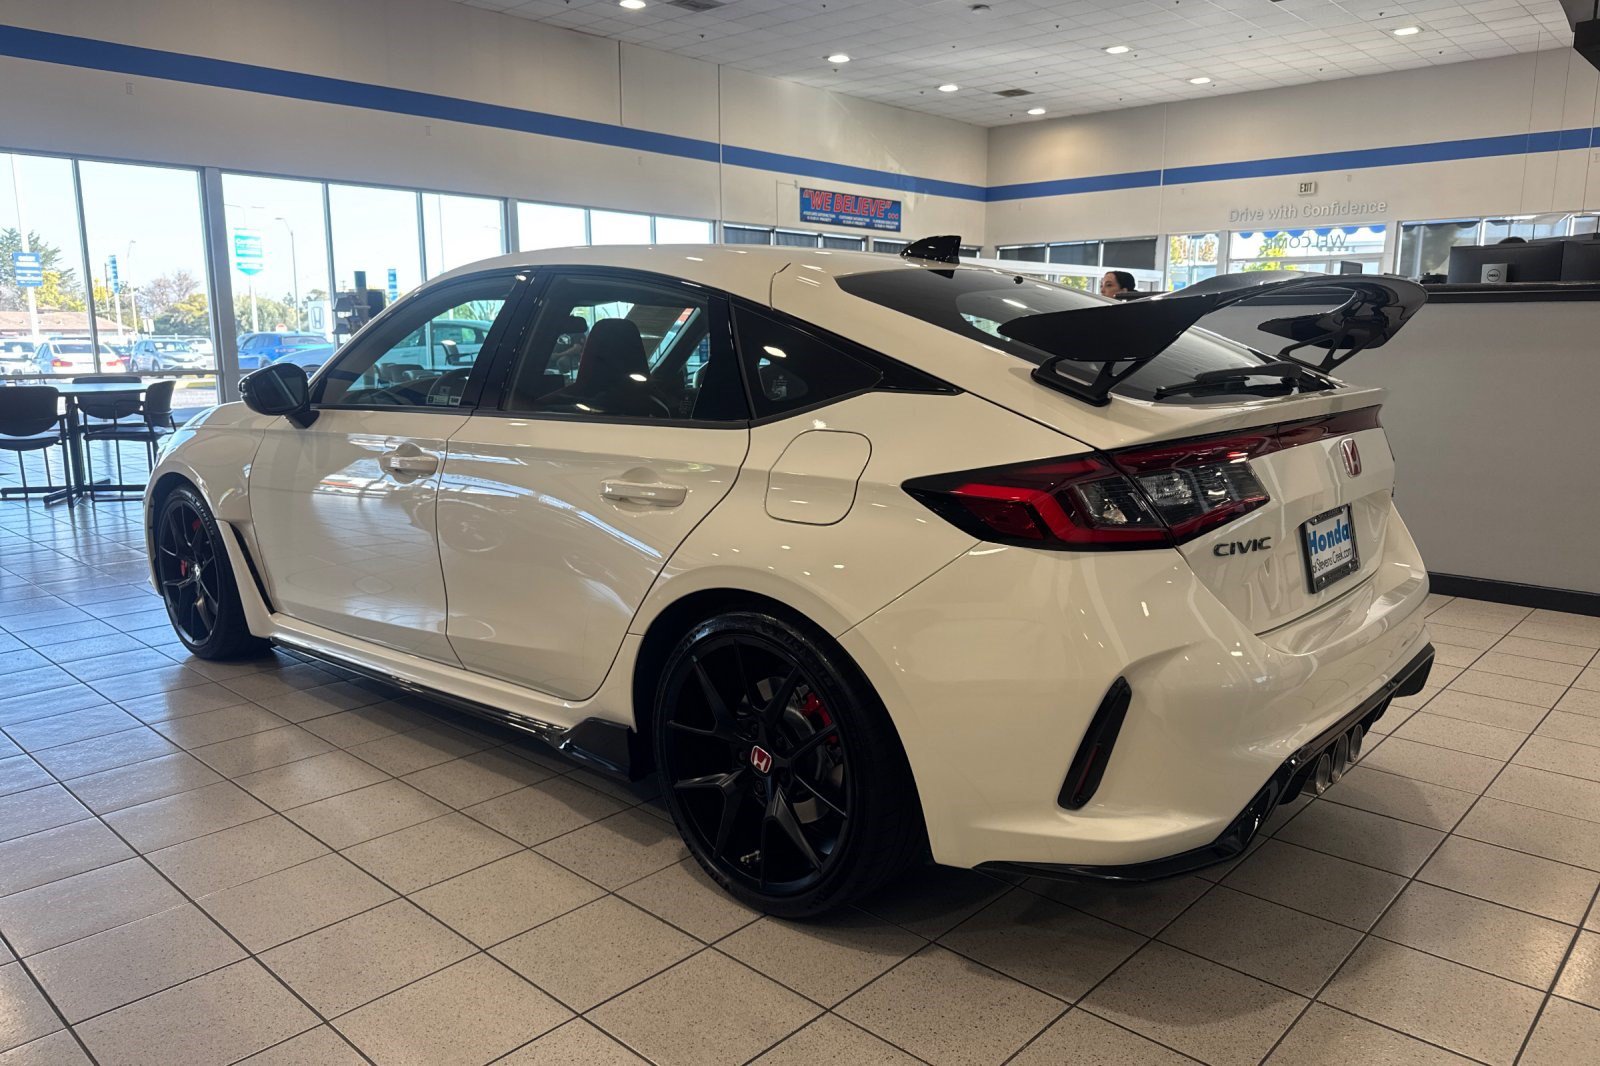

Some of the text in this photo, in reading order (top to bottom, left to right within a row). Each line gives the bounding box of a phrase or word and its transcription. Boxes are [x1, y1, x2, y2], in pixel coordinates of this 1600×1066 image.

[1300, 182, 1312, 192] EXIT
[1229, 200, 1388, 222] Drive with Confidence
[1213, 537, 1272, 557] CIVIC
[1308, 518, 1350, 556] Honda
